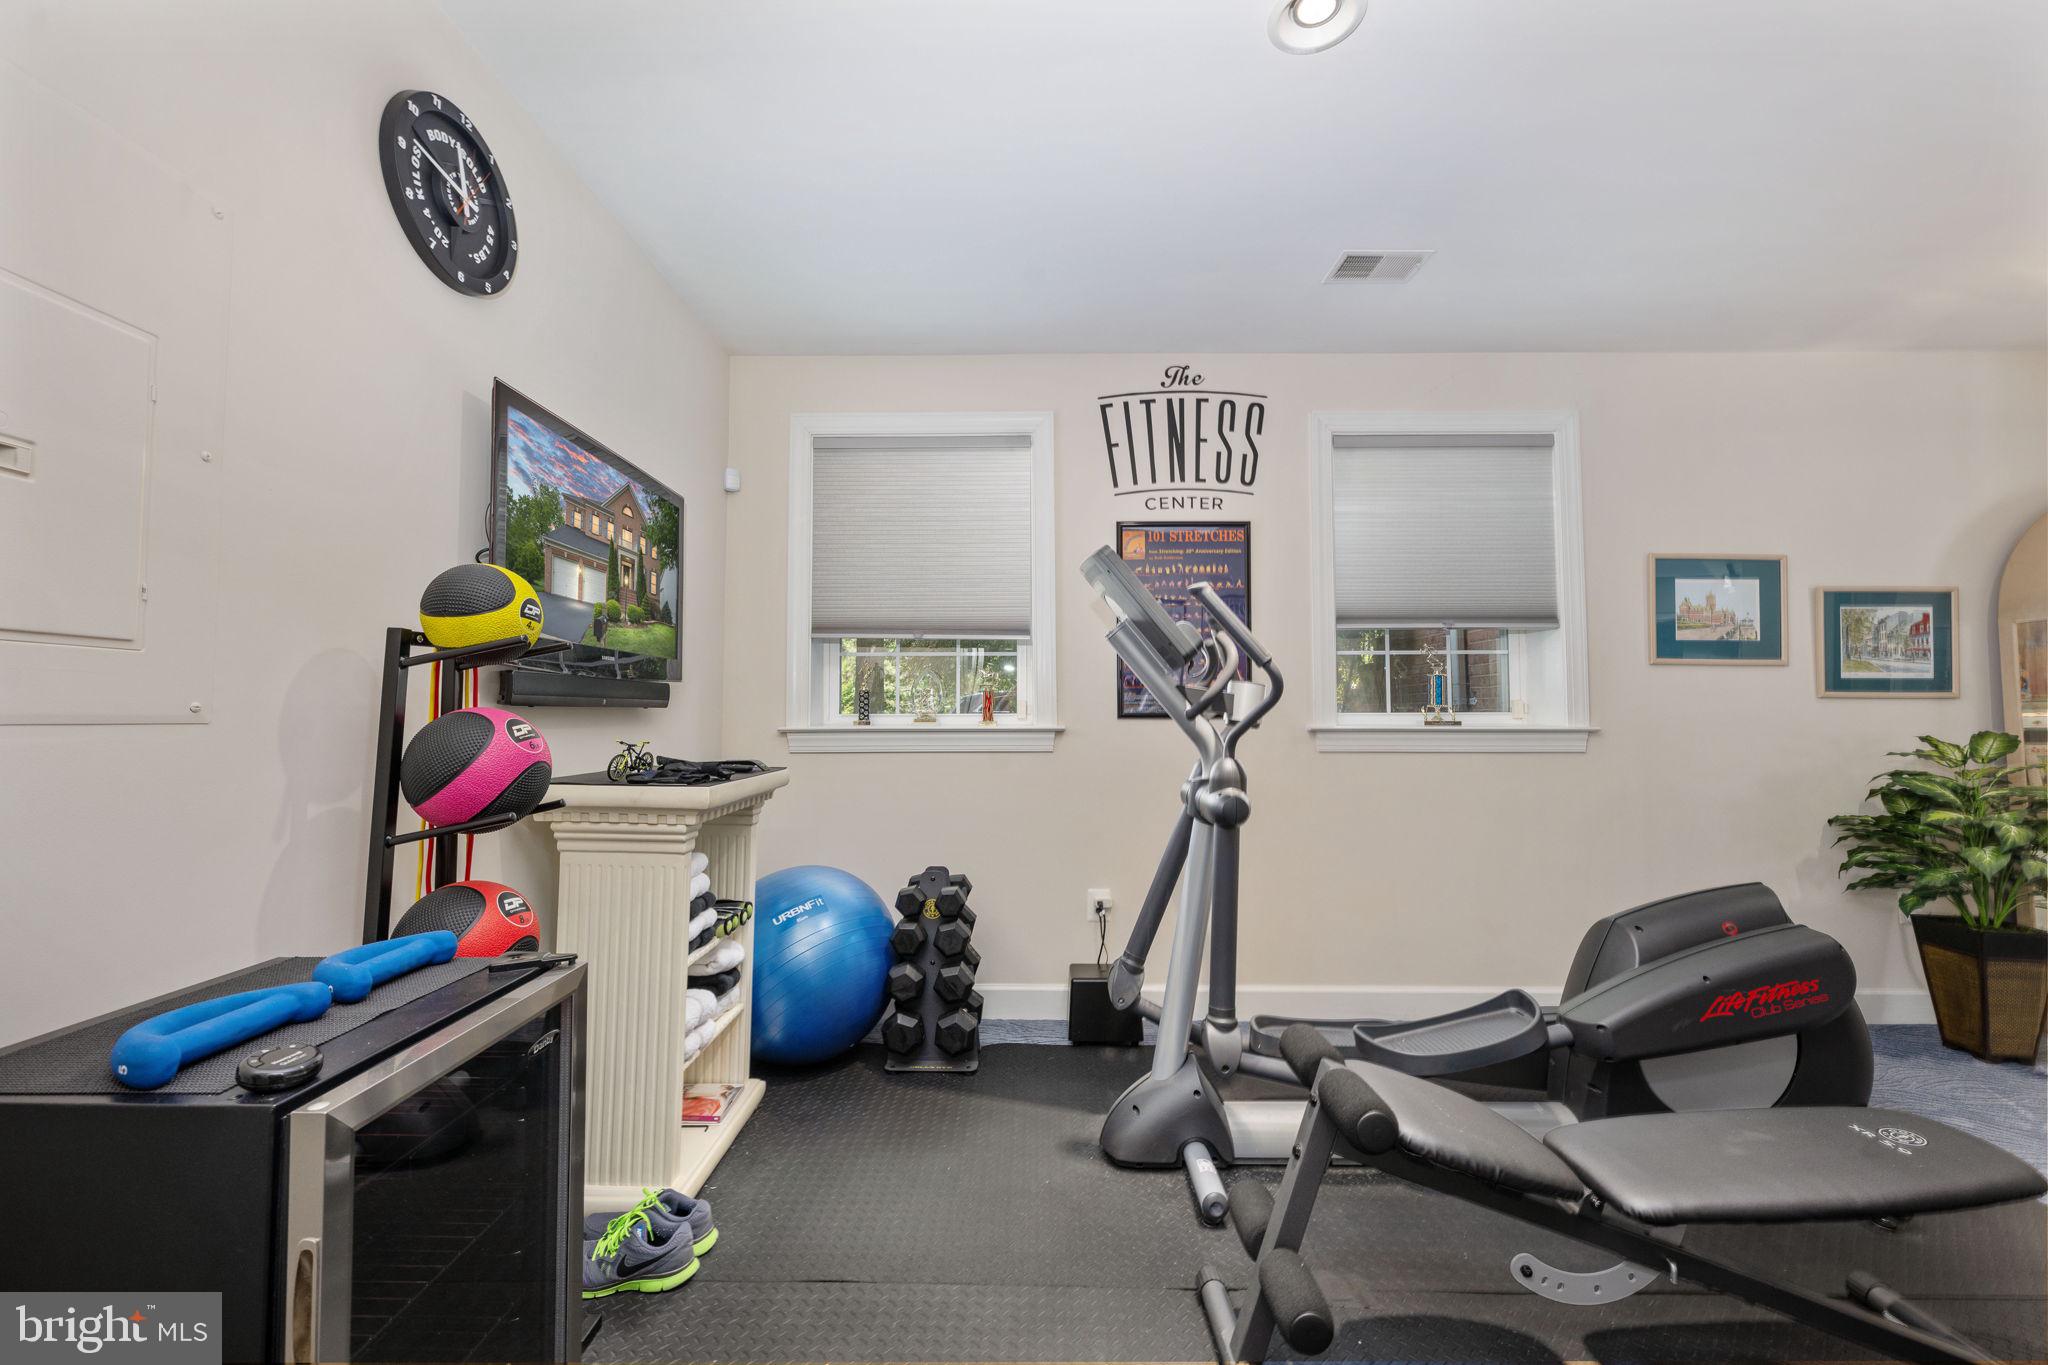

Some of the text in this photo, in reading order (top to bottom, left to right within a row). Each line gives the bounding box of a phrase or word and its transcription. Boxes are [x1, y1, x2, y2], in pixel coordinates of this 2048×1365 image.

[407, 100, 419, 117] 10
[459, 113, 473, 132] 12
[426, 129, 456, 149] BODY
[1160, 365, 1206, 389] The
[1100, 398, 1265, 489] FITNESS
[1144, 497, 1223, 511] CENTER
[1148, 529, 1245, 543] 101 STRETCHES
